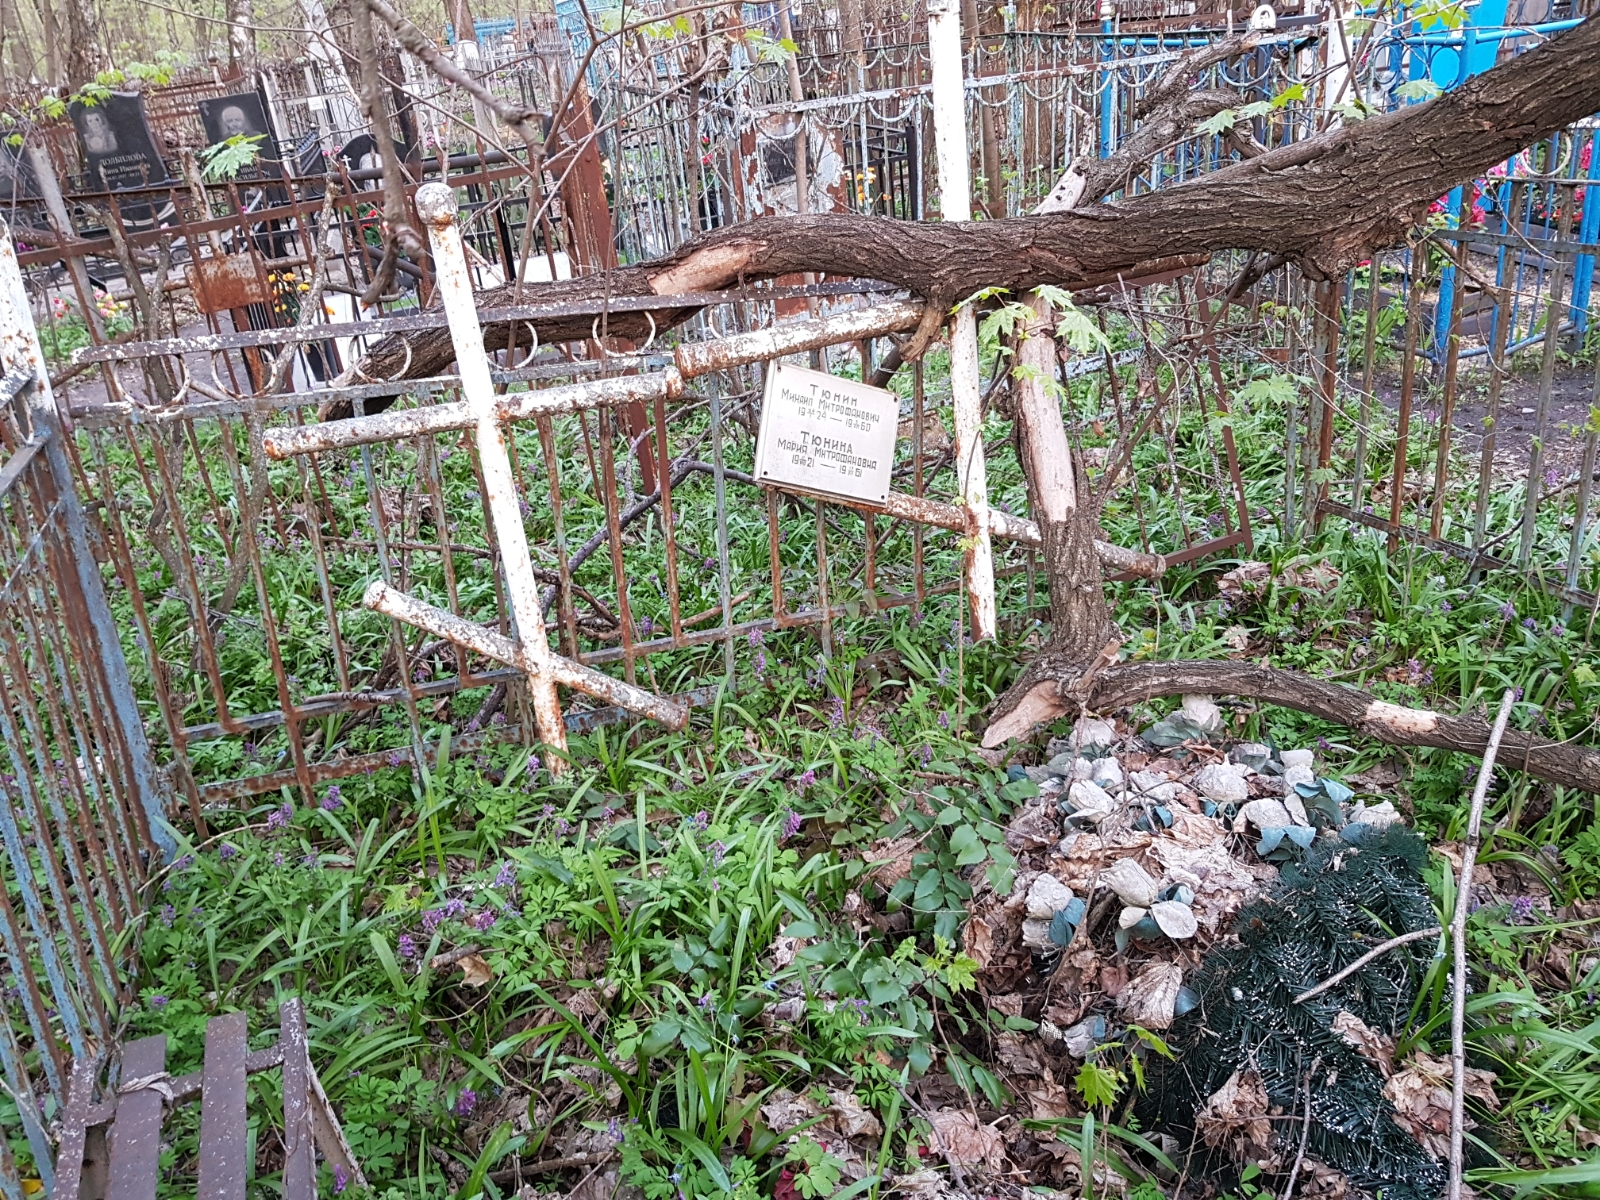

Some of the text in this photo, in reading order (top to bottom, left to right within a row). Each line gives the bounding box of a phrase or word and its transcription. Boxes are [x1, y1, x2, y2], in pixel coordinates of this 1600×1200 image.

[810, 384, 858, 406] ТЮНИН
[818, 399, 880, 424] Митрофанович
[777, 437, 877, 471] Мария Митрофановна
[800, 431, 853, 455] ТЮНИНА
